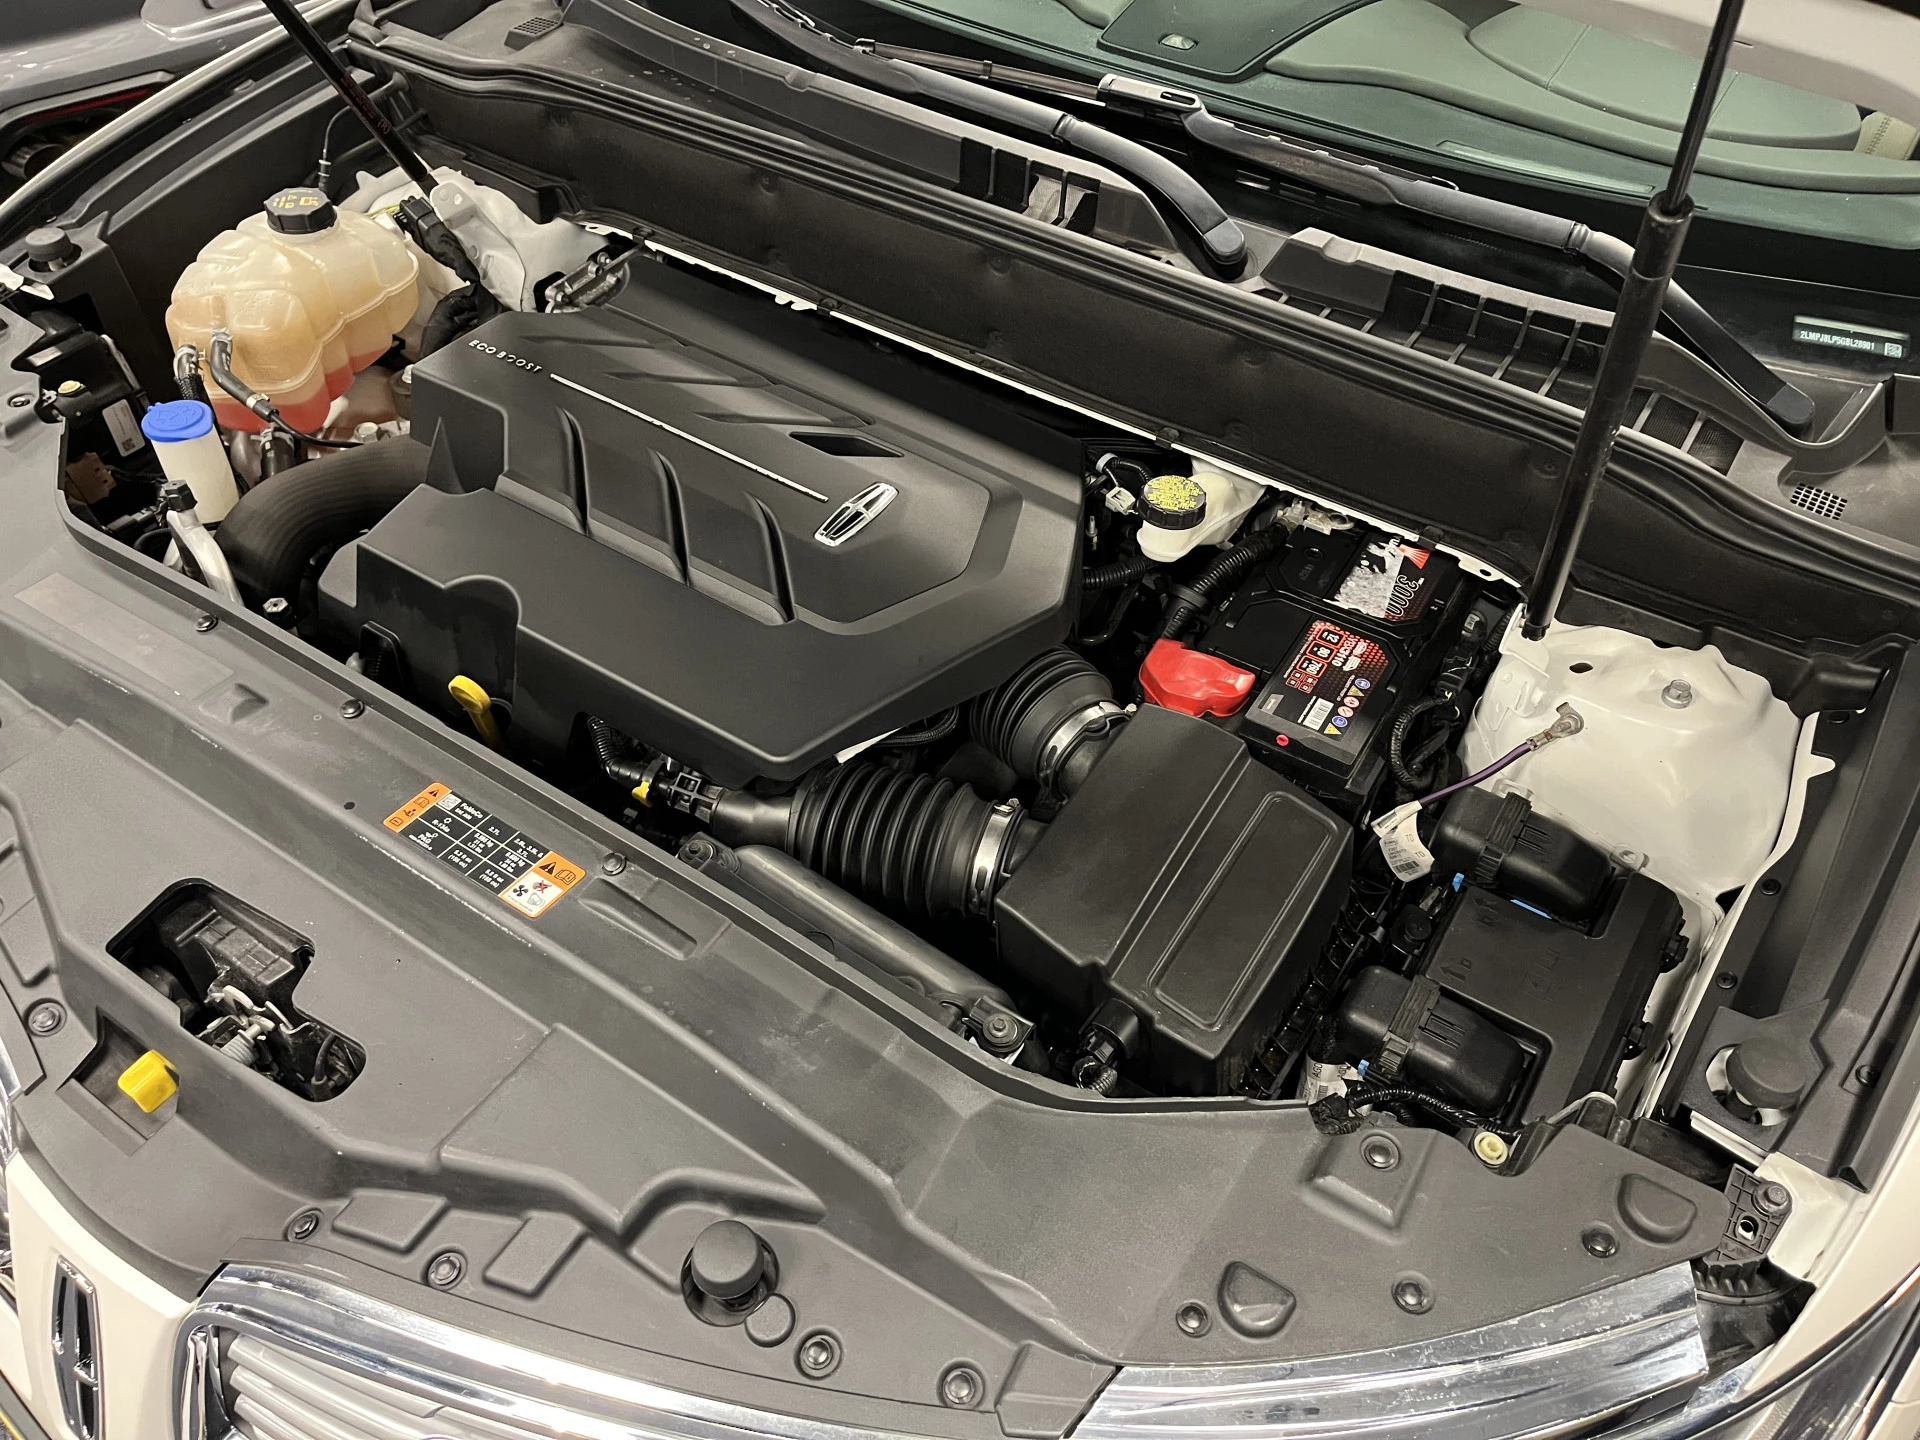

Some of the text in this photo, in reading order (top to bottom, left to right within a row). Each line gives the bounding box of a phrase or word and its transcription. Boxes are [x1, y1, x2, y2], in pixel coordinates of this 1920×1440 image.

[1327, 633, 1340, 643] 12
[1306, 660, 1323, 675] 760
[418, 833, 432, 844] PAG
